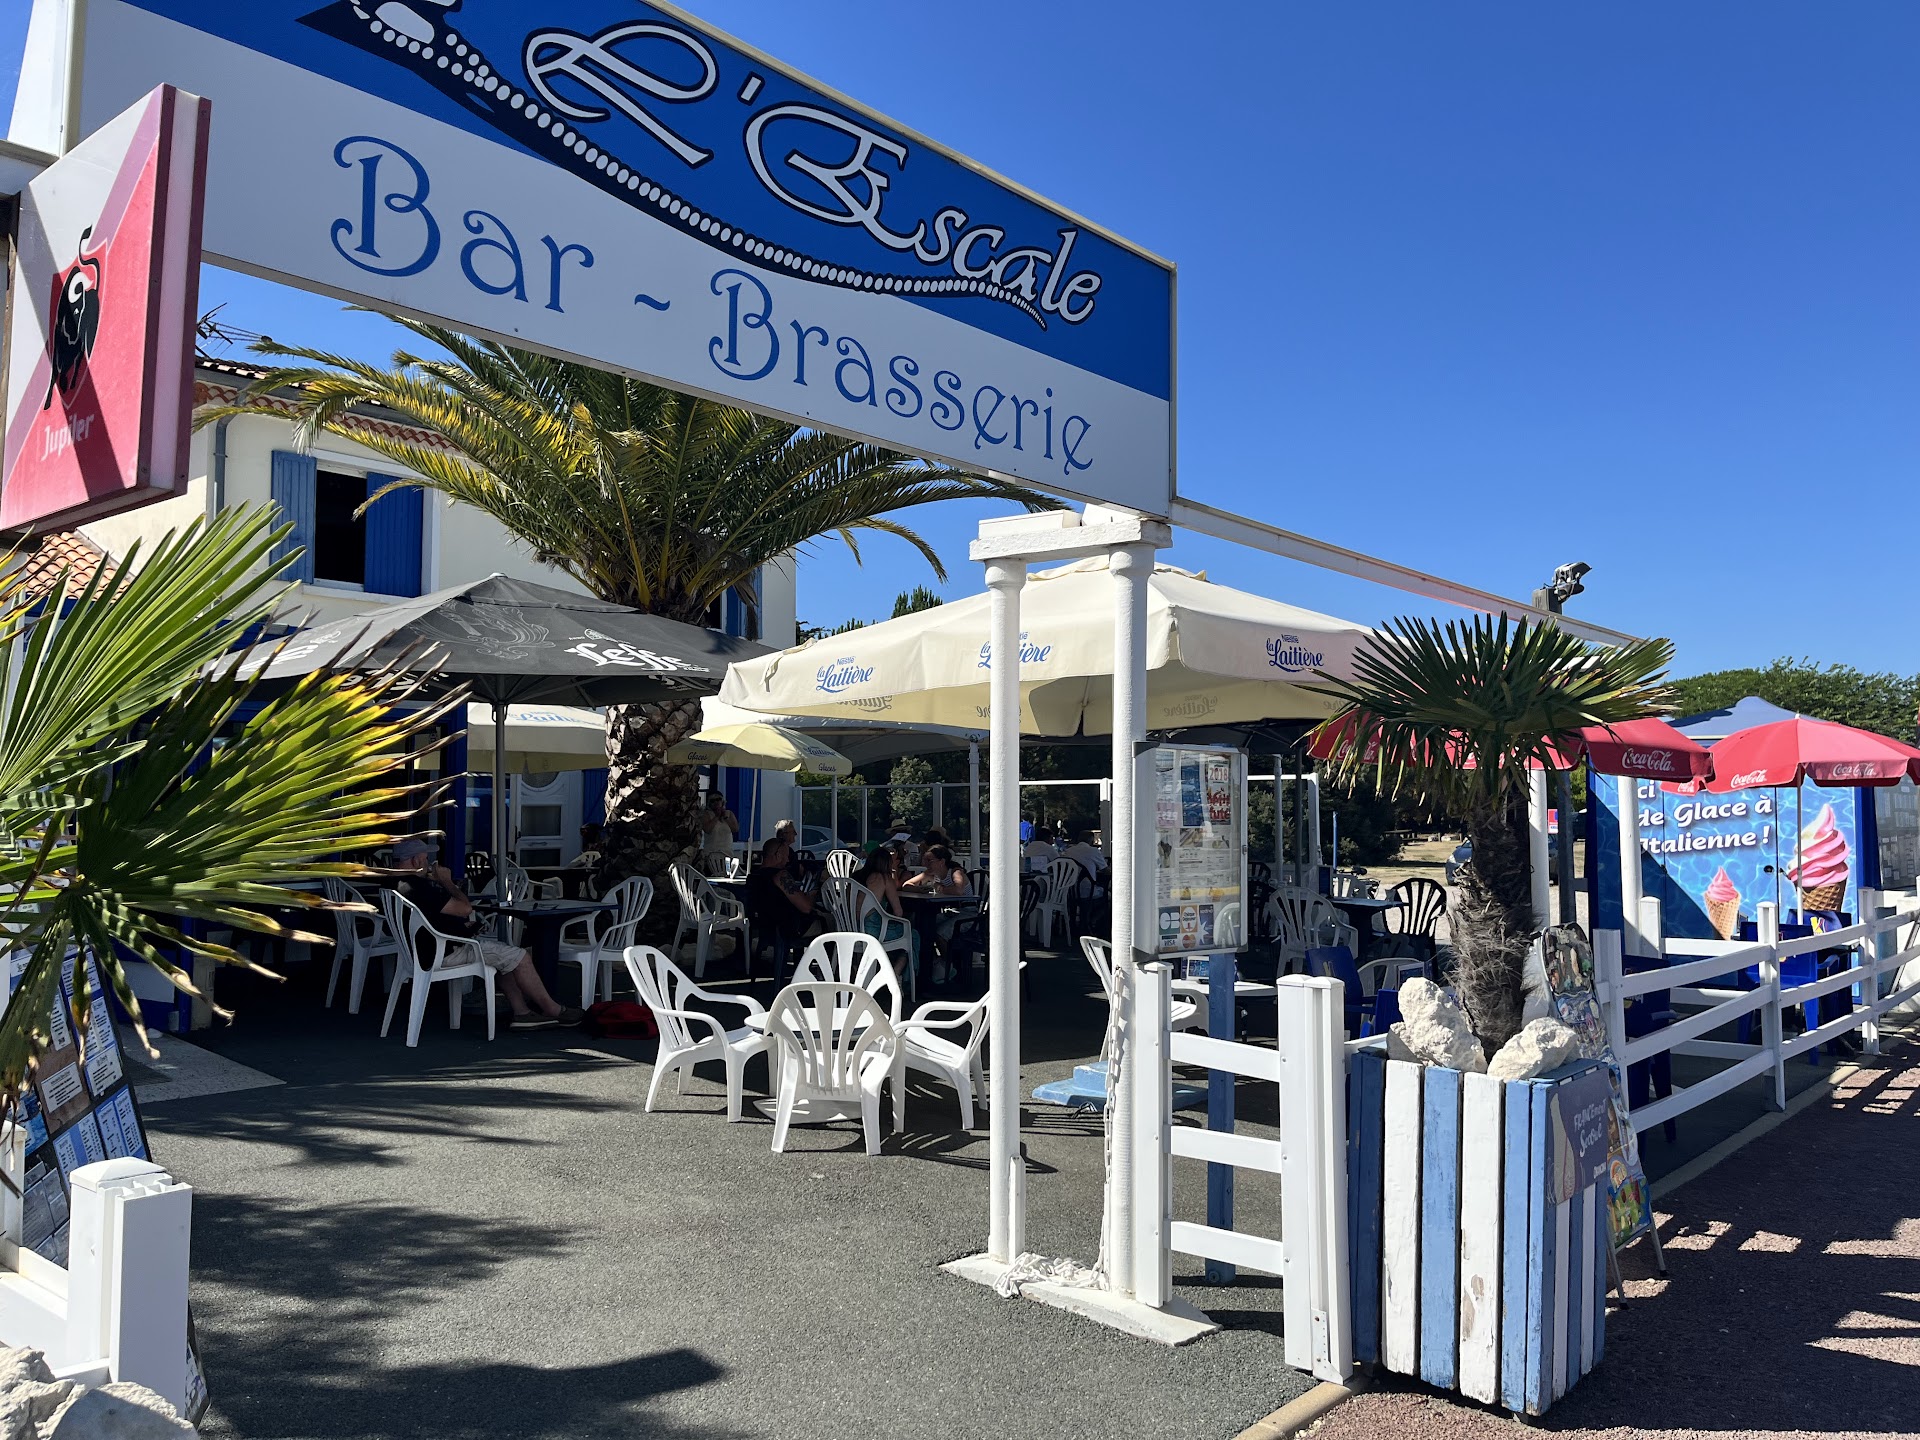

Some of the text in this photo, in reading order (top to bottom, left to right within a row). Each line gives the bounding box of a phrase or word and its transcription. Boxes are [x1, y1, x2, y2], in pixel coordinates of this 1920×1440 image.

[331, 136, 594, 313] Bar
[709, 269, 1093, 475] Brasserie
[41, 413, 94, 461] Jupiler
[1281, 634, 1299, 643] Nestlé
[564, 643, 691, 671] Leffe
[837, 656, 855, 665] Nestlé
[1269, 639, 1324, 672] Laitière
[816, 664, 873, 693] Laitière
[1209, 768, 1229, 780] 2018
[1674, 802, 1747, 827] Glace
[1755, 795, 1772, 814] à
